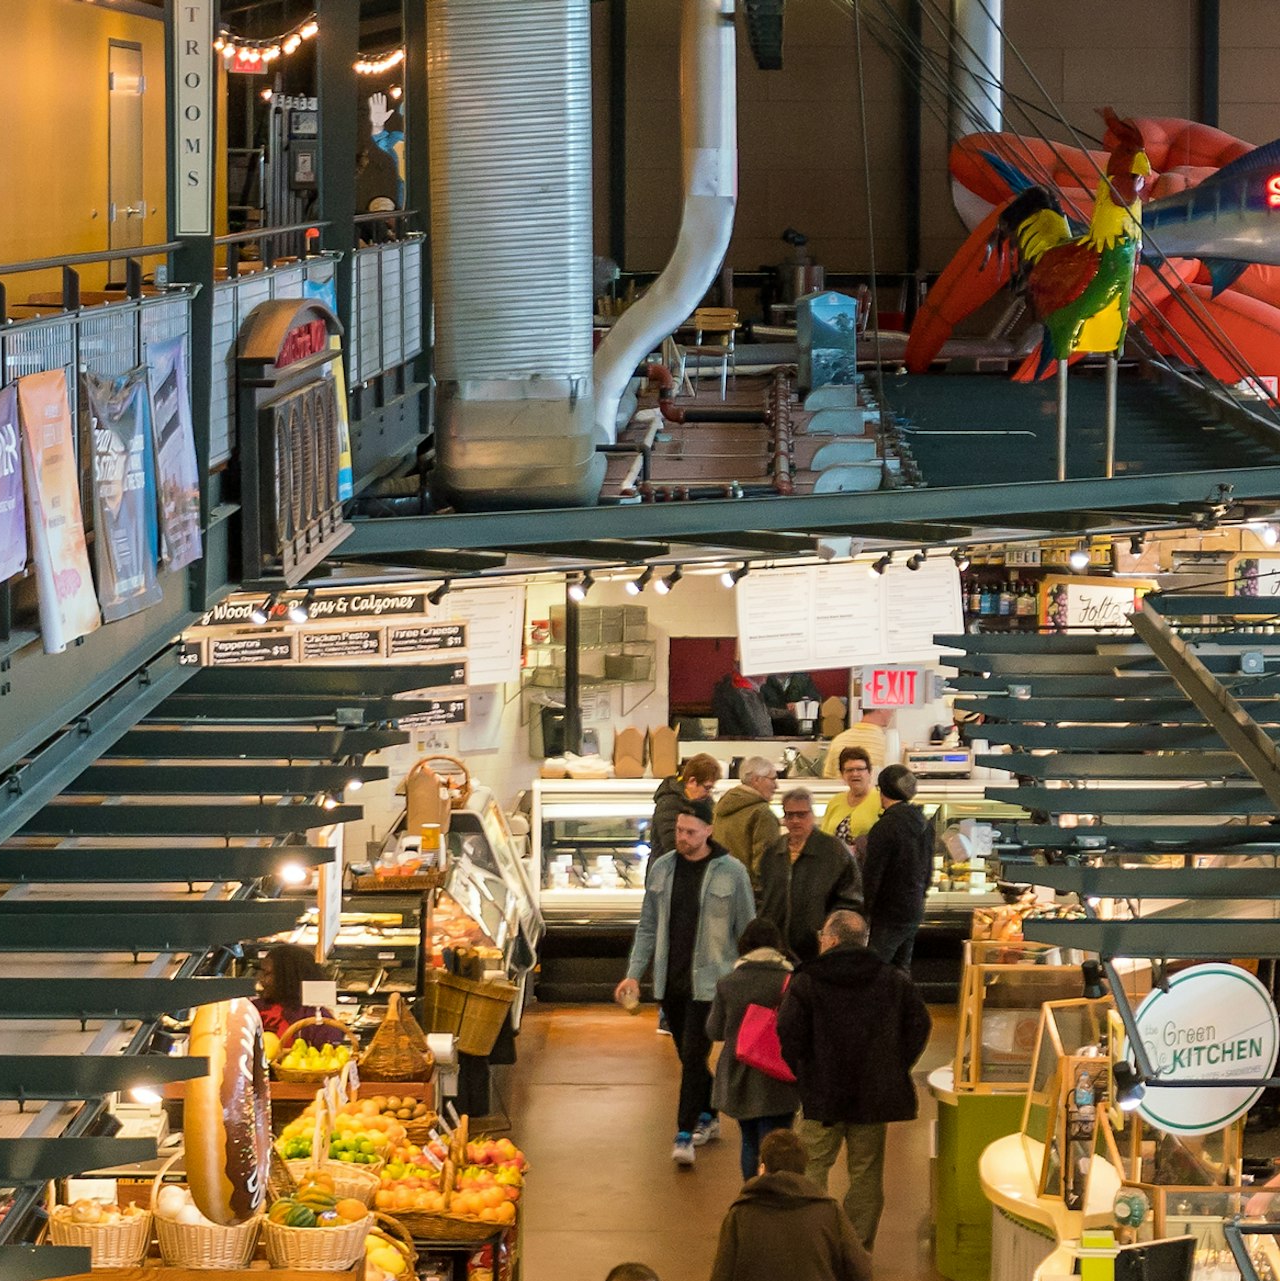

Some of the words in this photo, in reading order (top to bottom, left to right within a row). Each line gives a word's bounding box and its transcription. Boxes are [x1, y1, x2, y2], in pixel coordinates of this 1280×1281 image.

[213, 603, 256, 620] Wood
[337, 597, 347, 612] &
[350, 596, 415, 618] Calzones
[304, 633, 341, 644] Chicken
[342, 631, 370, 641] Pesto
[420, 625, 460, 637] Cheese
[214, 639, 261, 651] Pepperoni
[872, 670, 918, 704] EXIT
[1163, 1020, 1216, 1047] Green
[1164, 1037, 1263, 1074] KITCHEN
